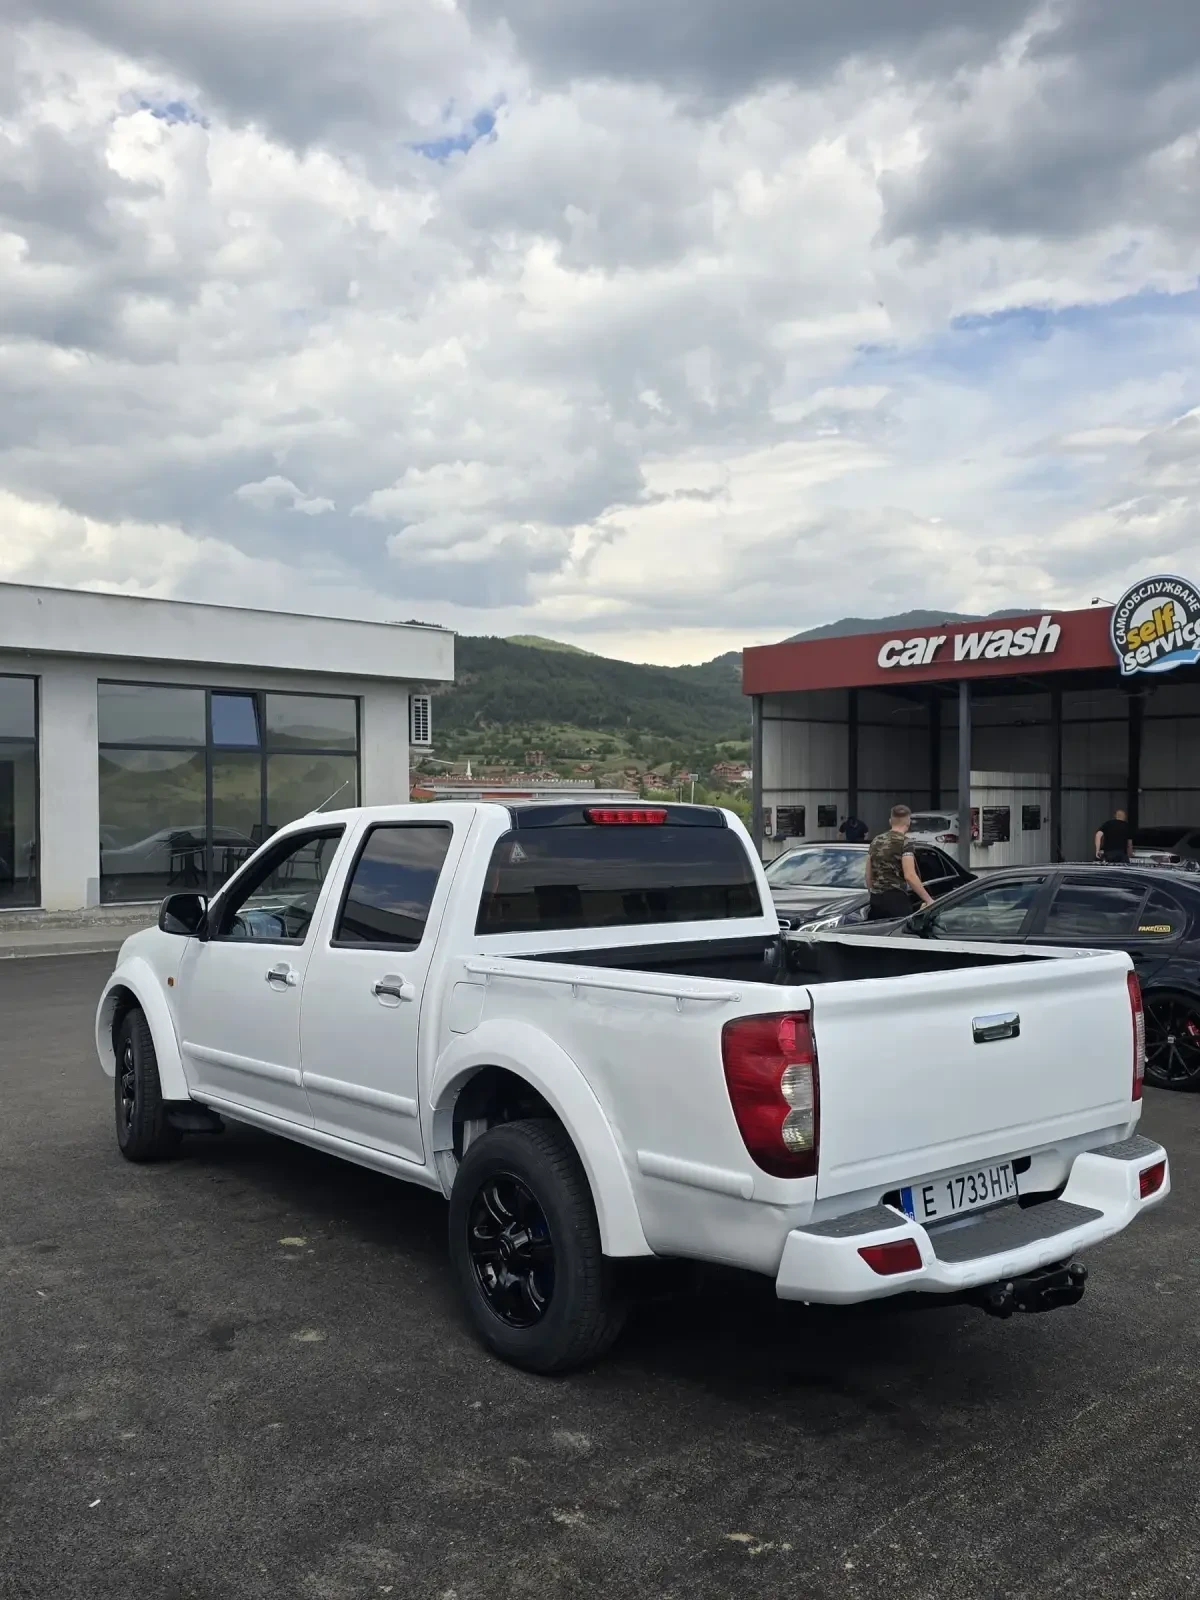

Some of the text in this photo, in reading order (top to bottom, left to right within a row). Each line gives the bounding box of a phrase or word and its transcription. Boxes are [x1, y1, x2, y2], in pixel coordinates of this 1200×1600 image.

[1116, 582, 1200, 645] САМООБСЛУЖВАНЕ
[1126, 601, 1174, 650] self
[877, 616, 1061, 668] car wash
[922, 1185, 937, 1217] E
